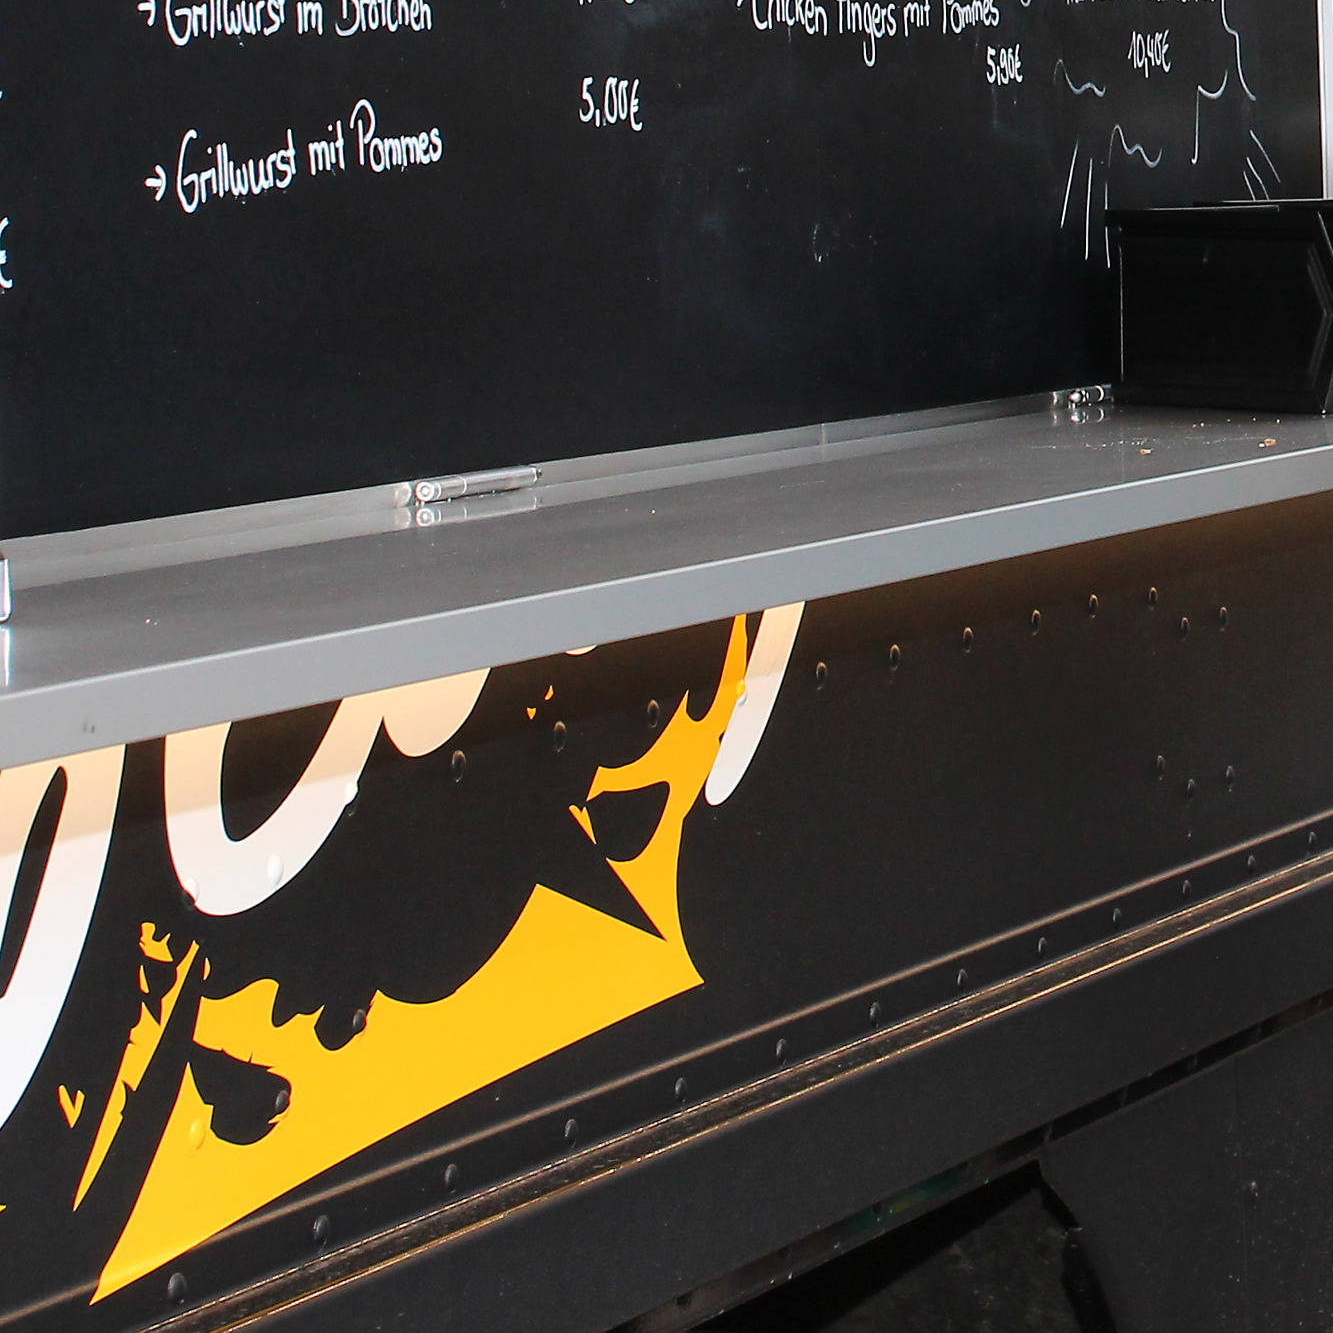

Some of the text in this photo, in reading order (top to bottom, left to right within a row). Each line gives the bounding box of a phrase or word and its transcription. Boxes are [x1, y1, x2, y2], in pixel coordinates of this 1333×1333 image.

[986, 43, 1023, 86] 5,90€
[579, 76, 643, 132] 5,00€
[176, 98, 443, 214] Grillwurst mit Pommes
